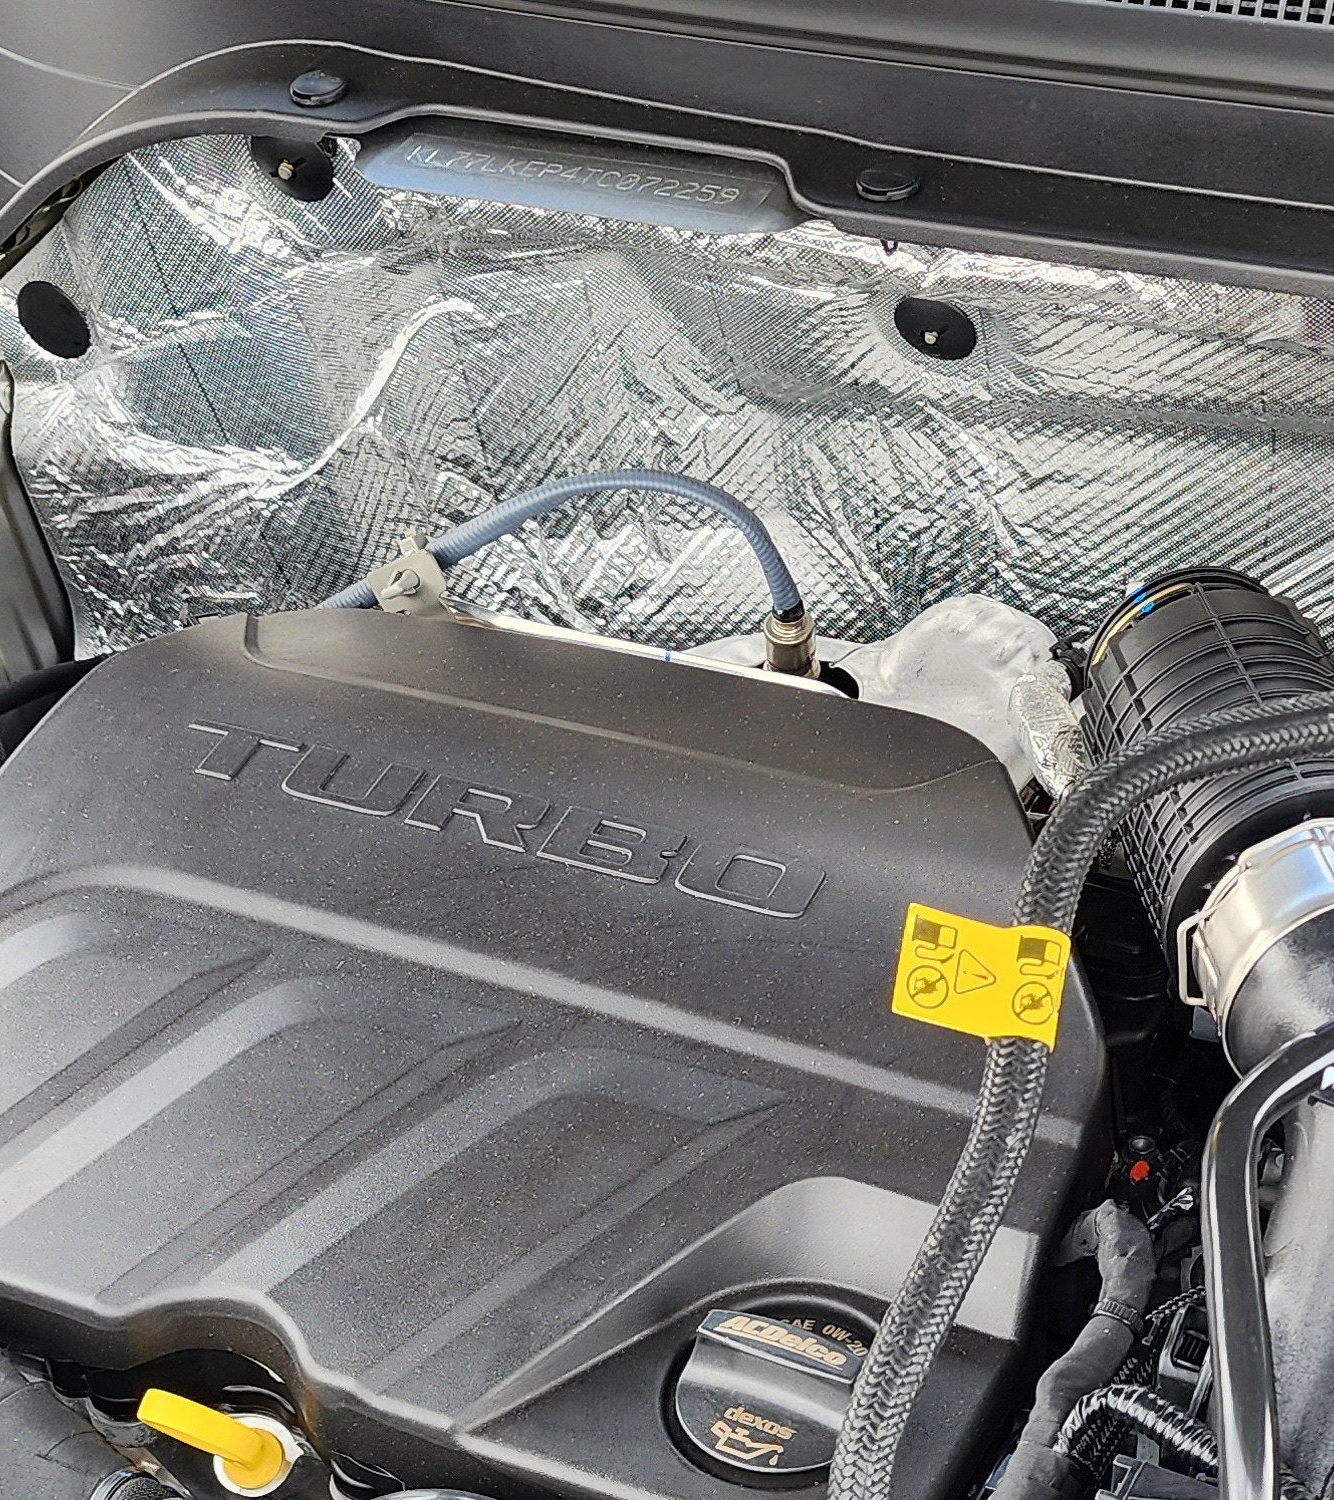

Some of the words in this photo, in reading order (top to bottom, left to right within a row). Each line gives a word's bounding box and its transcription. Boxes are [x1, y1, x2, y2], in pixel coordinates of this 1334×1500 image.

[405, 145, 741, 205] KL77LKEP4TC072259
[187, 720, 827, 920] TURBO
[714, 1314, 848, 1367] ACDelco
[781, 1317, 817, 1333] AE
[821, 1324, 869, 1358] 0W-20
[723, 1405, 796, 1441] dexos
